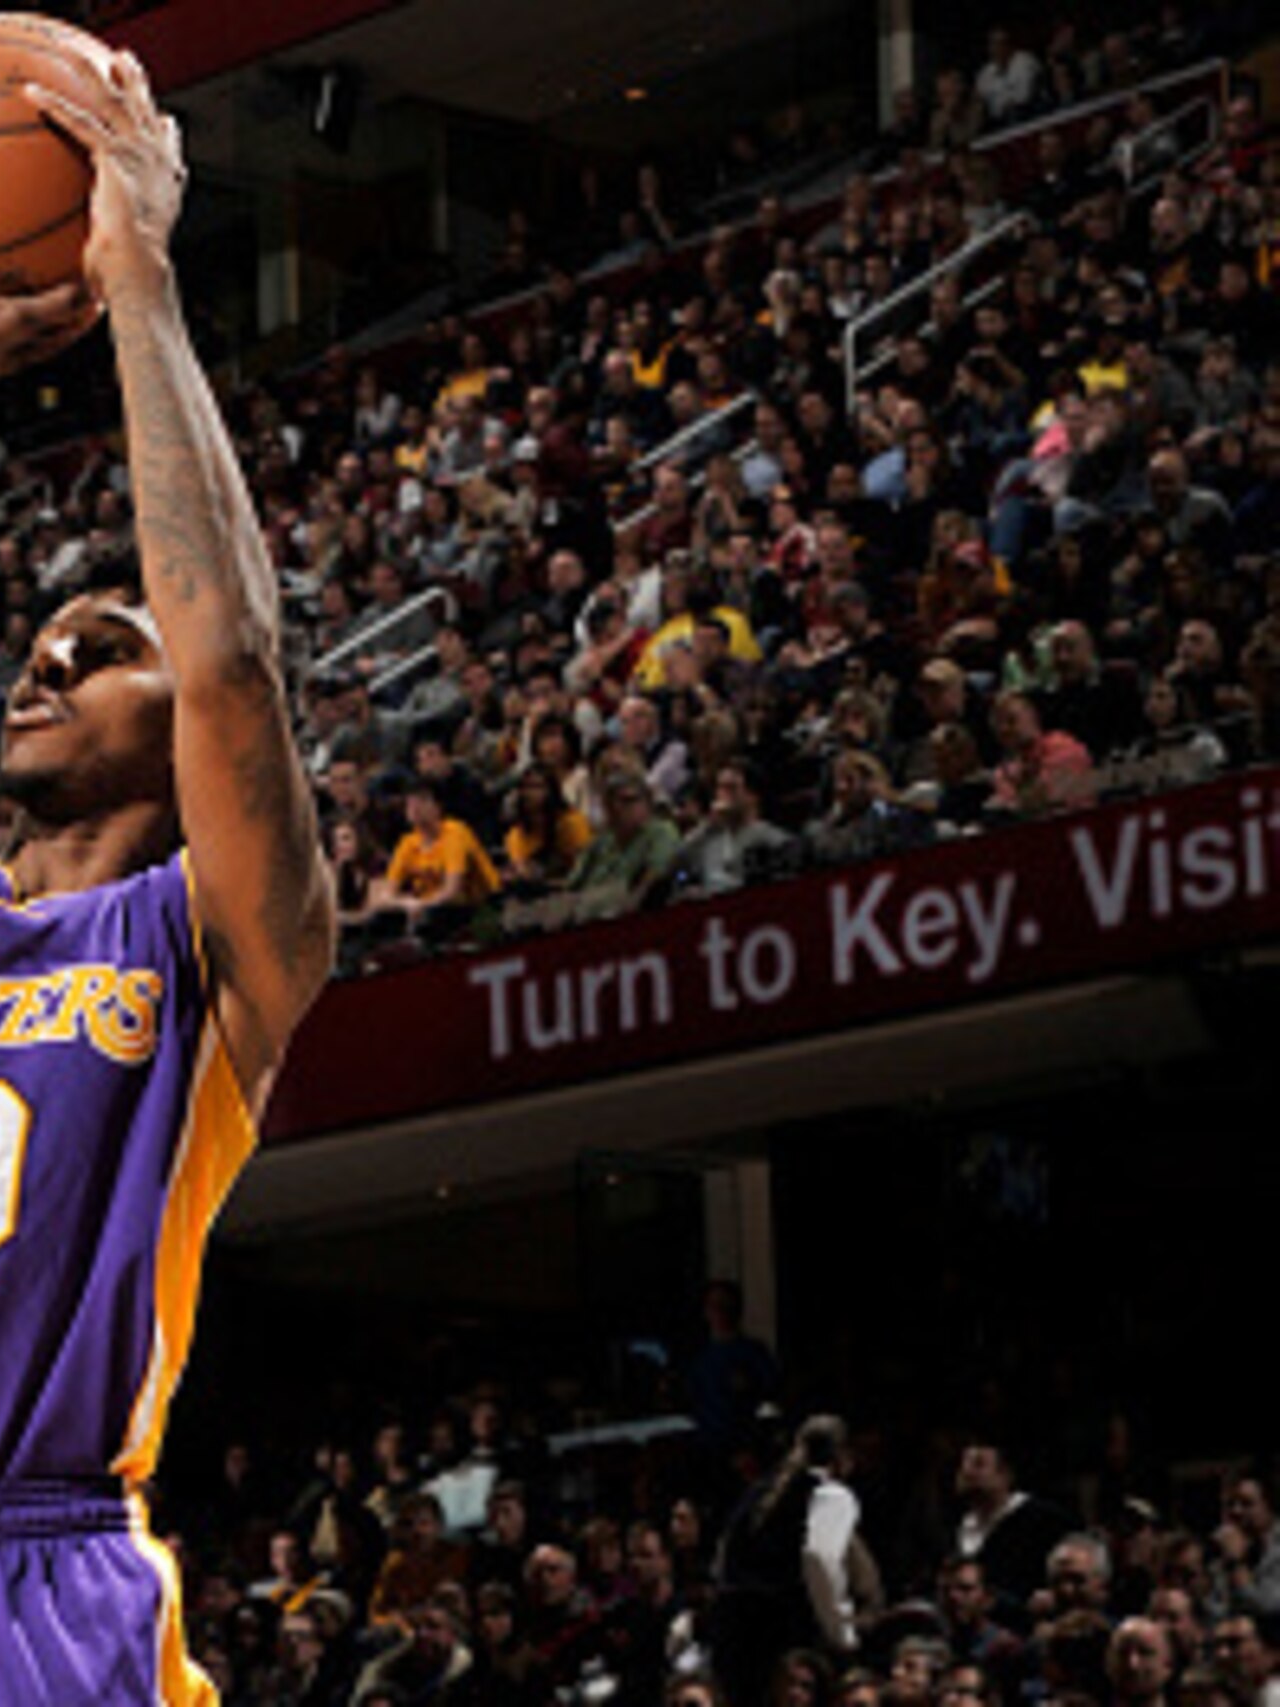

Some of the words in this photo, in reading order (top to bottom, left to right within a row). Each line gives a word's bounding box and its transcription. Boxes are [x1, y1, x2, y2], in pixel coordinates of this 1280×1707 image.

[470, 950, 671, 1060] Turn
[700, 915, 797, 1010] to
[828, 871, 1040, 986] Key.
